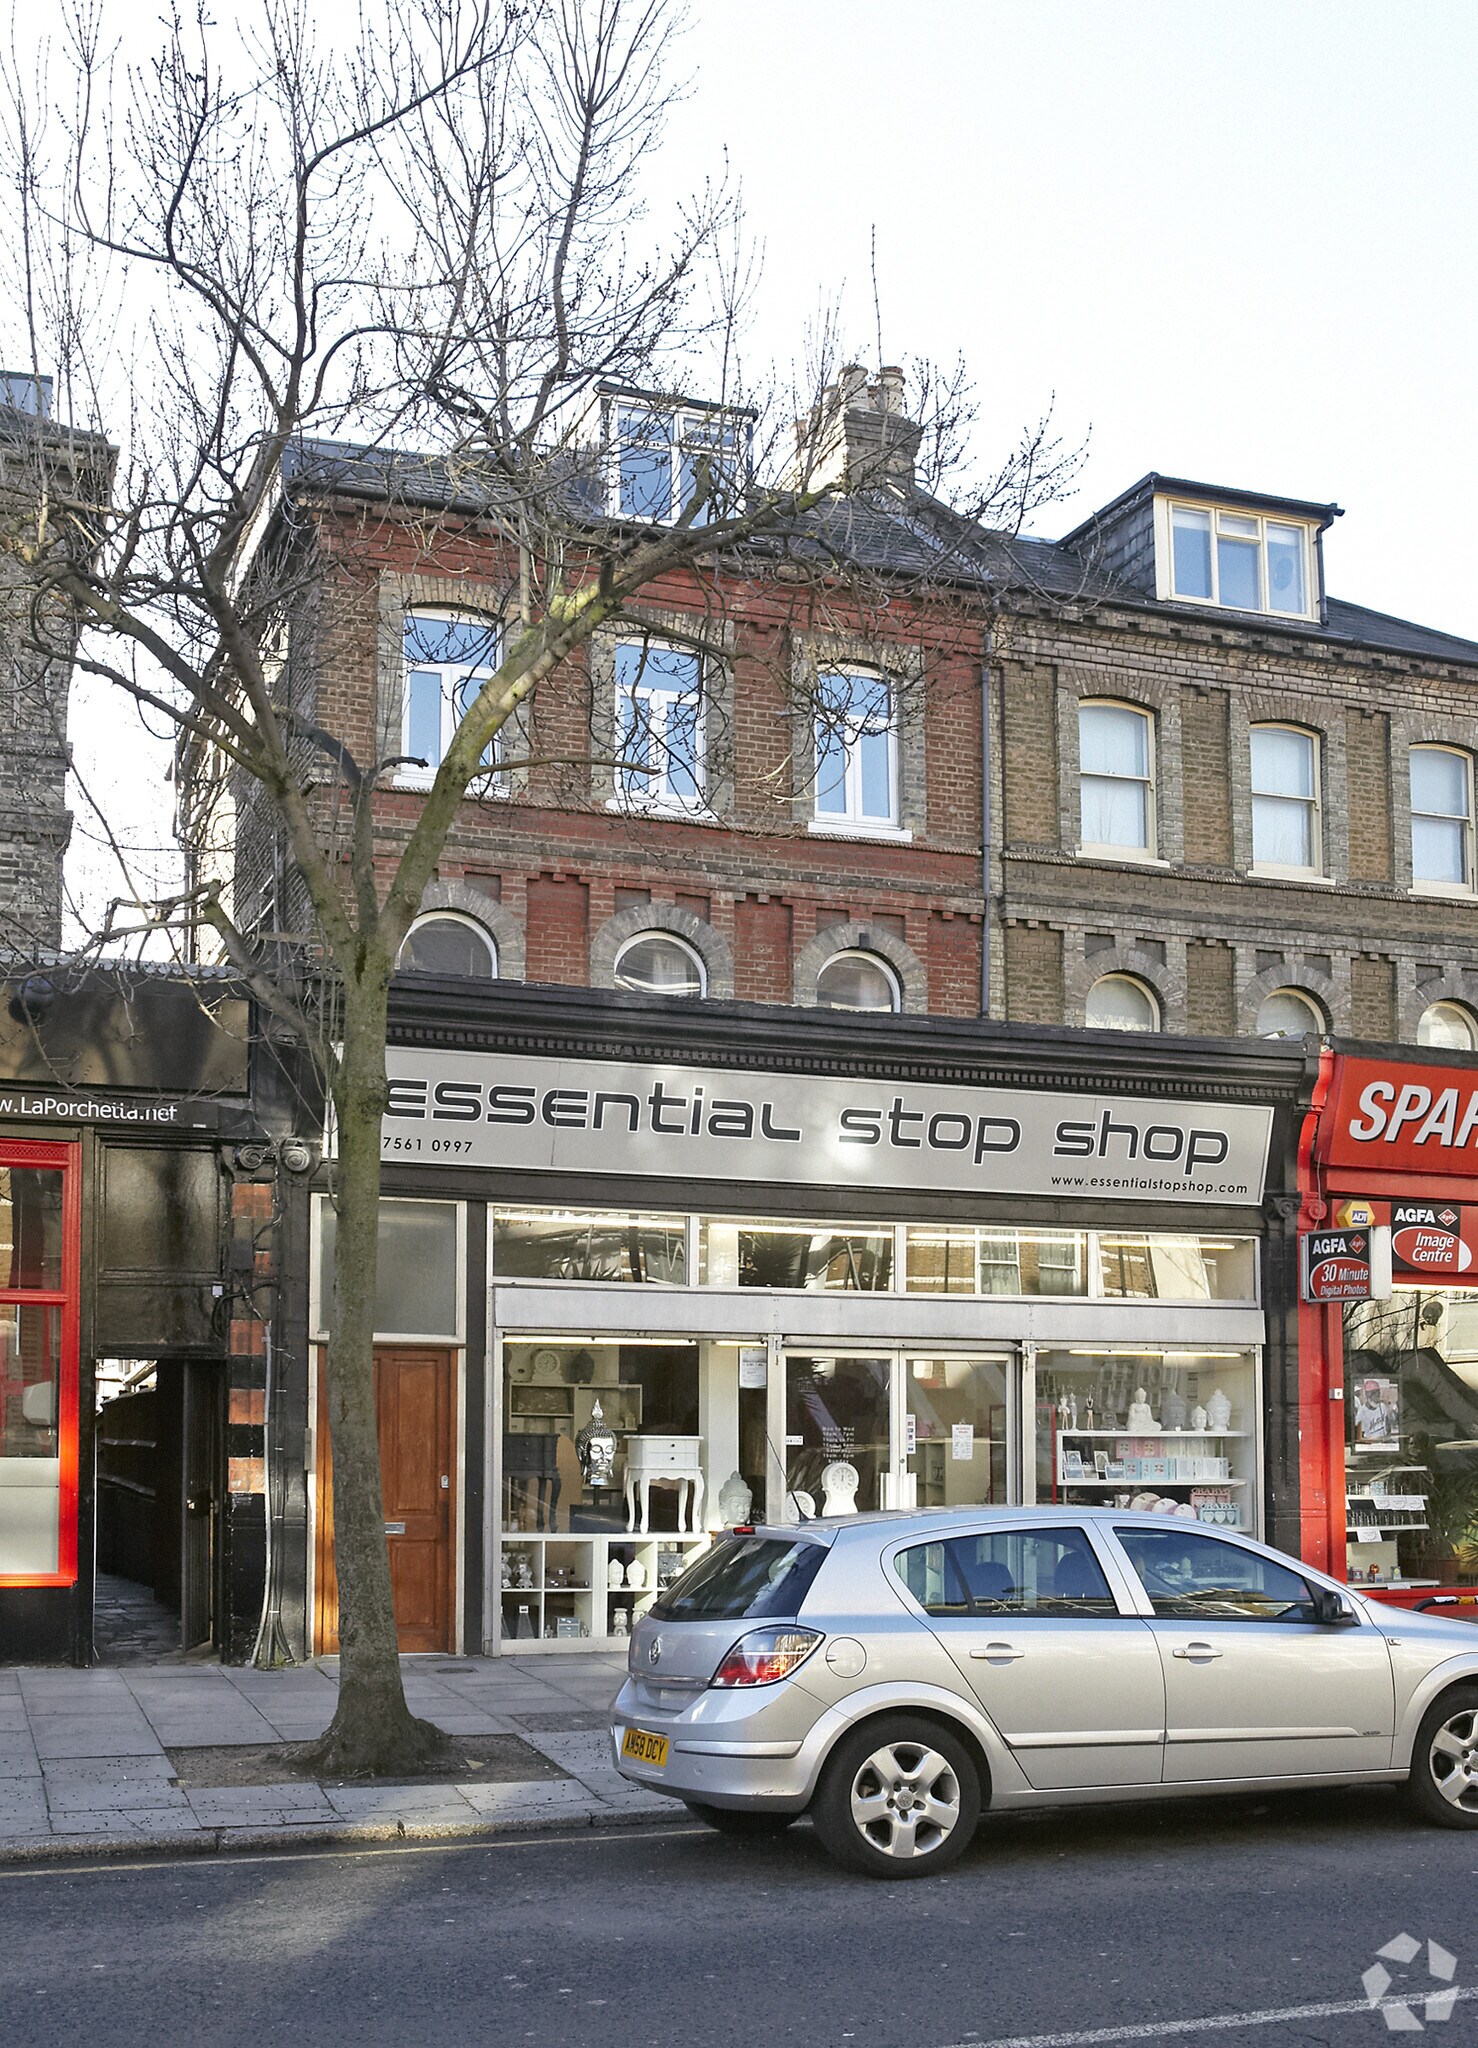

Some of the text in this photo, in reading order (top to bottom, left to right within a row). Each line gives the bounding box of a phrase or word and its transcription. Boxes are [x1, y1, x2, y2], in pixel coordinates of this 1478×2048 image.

[383, 1136, 473, 1153] 7561 0997
[838, 1096, 1022, 1166] stop
[1052, 1109, 1231, 1176] shop
[1050, 1176, 1249, 1195] www.essentialstopshop.com
[1352, 1211, 1368, 1222] ADT
[1394, 1207, 1436, 1224] AGFA
[1312, 1237, 1348, 1255] AGFA
[1415, 1231, 1455, 1251] Image
[1411, 1247, 1453, 1263] Centre
[1321, 1263, 1369, 1282] 30 Minute
[1320, 1284, 1368, 1297] Digital Photos
[646, 1737, 665, 1761] DCY
